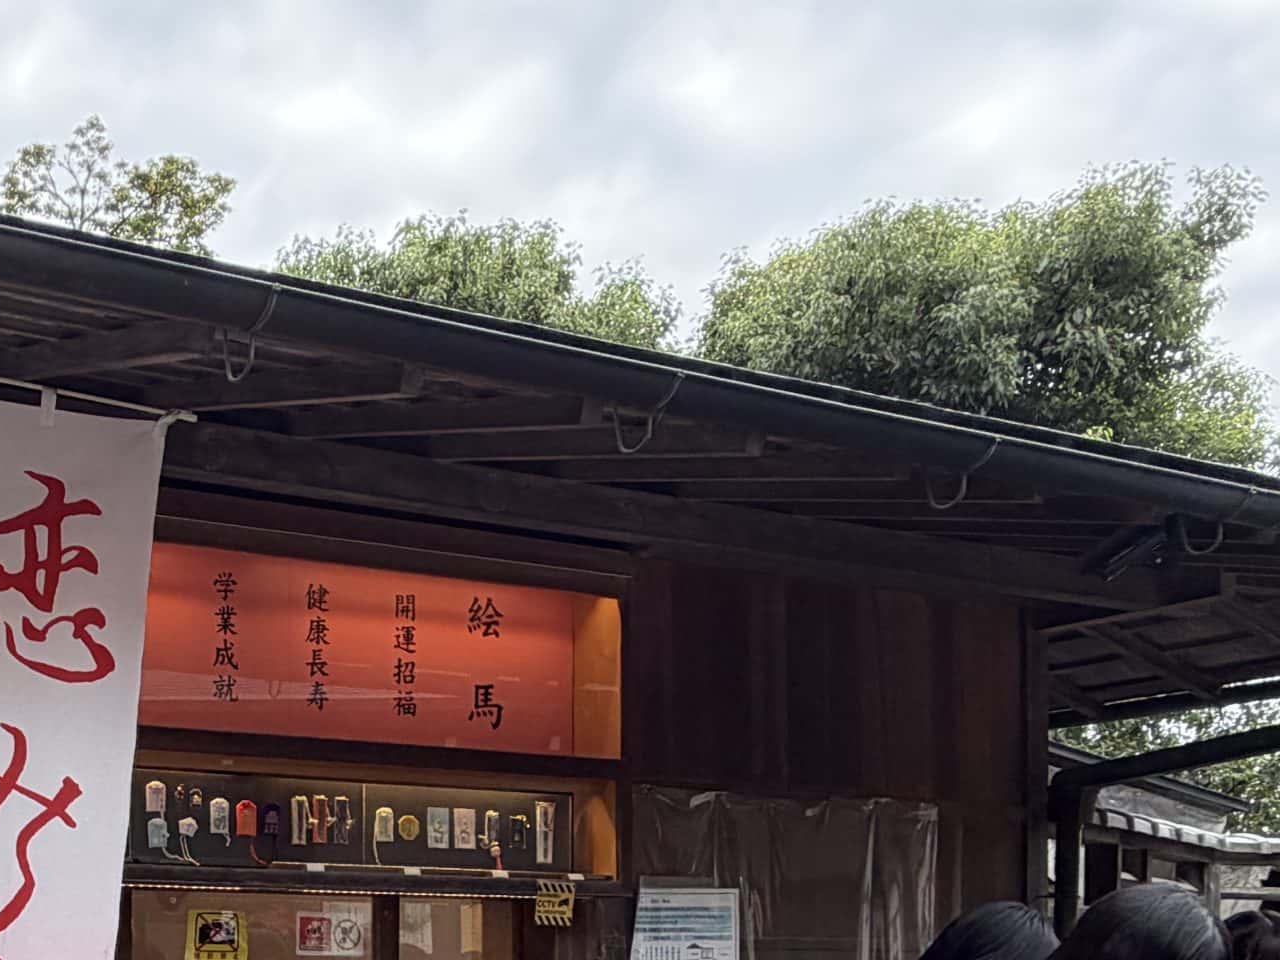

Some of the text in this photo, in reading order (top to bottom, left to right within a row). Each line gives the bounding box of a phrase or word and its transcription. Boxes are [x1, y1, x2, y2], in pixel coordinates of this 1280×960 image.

[212, 571, 239, 703] 学業成就
[305, 583, 331, 711] 健康長寿
[392, 594, 417, 718] 開運招福
[466, 596, 504, 730] 絵馬
